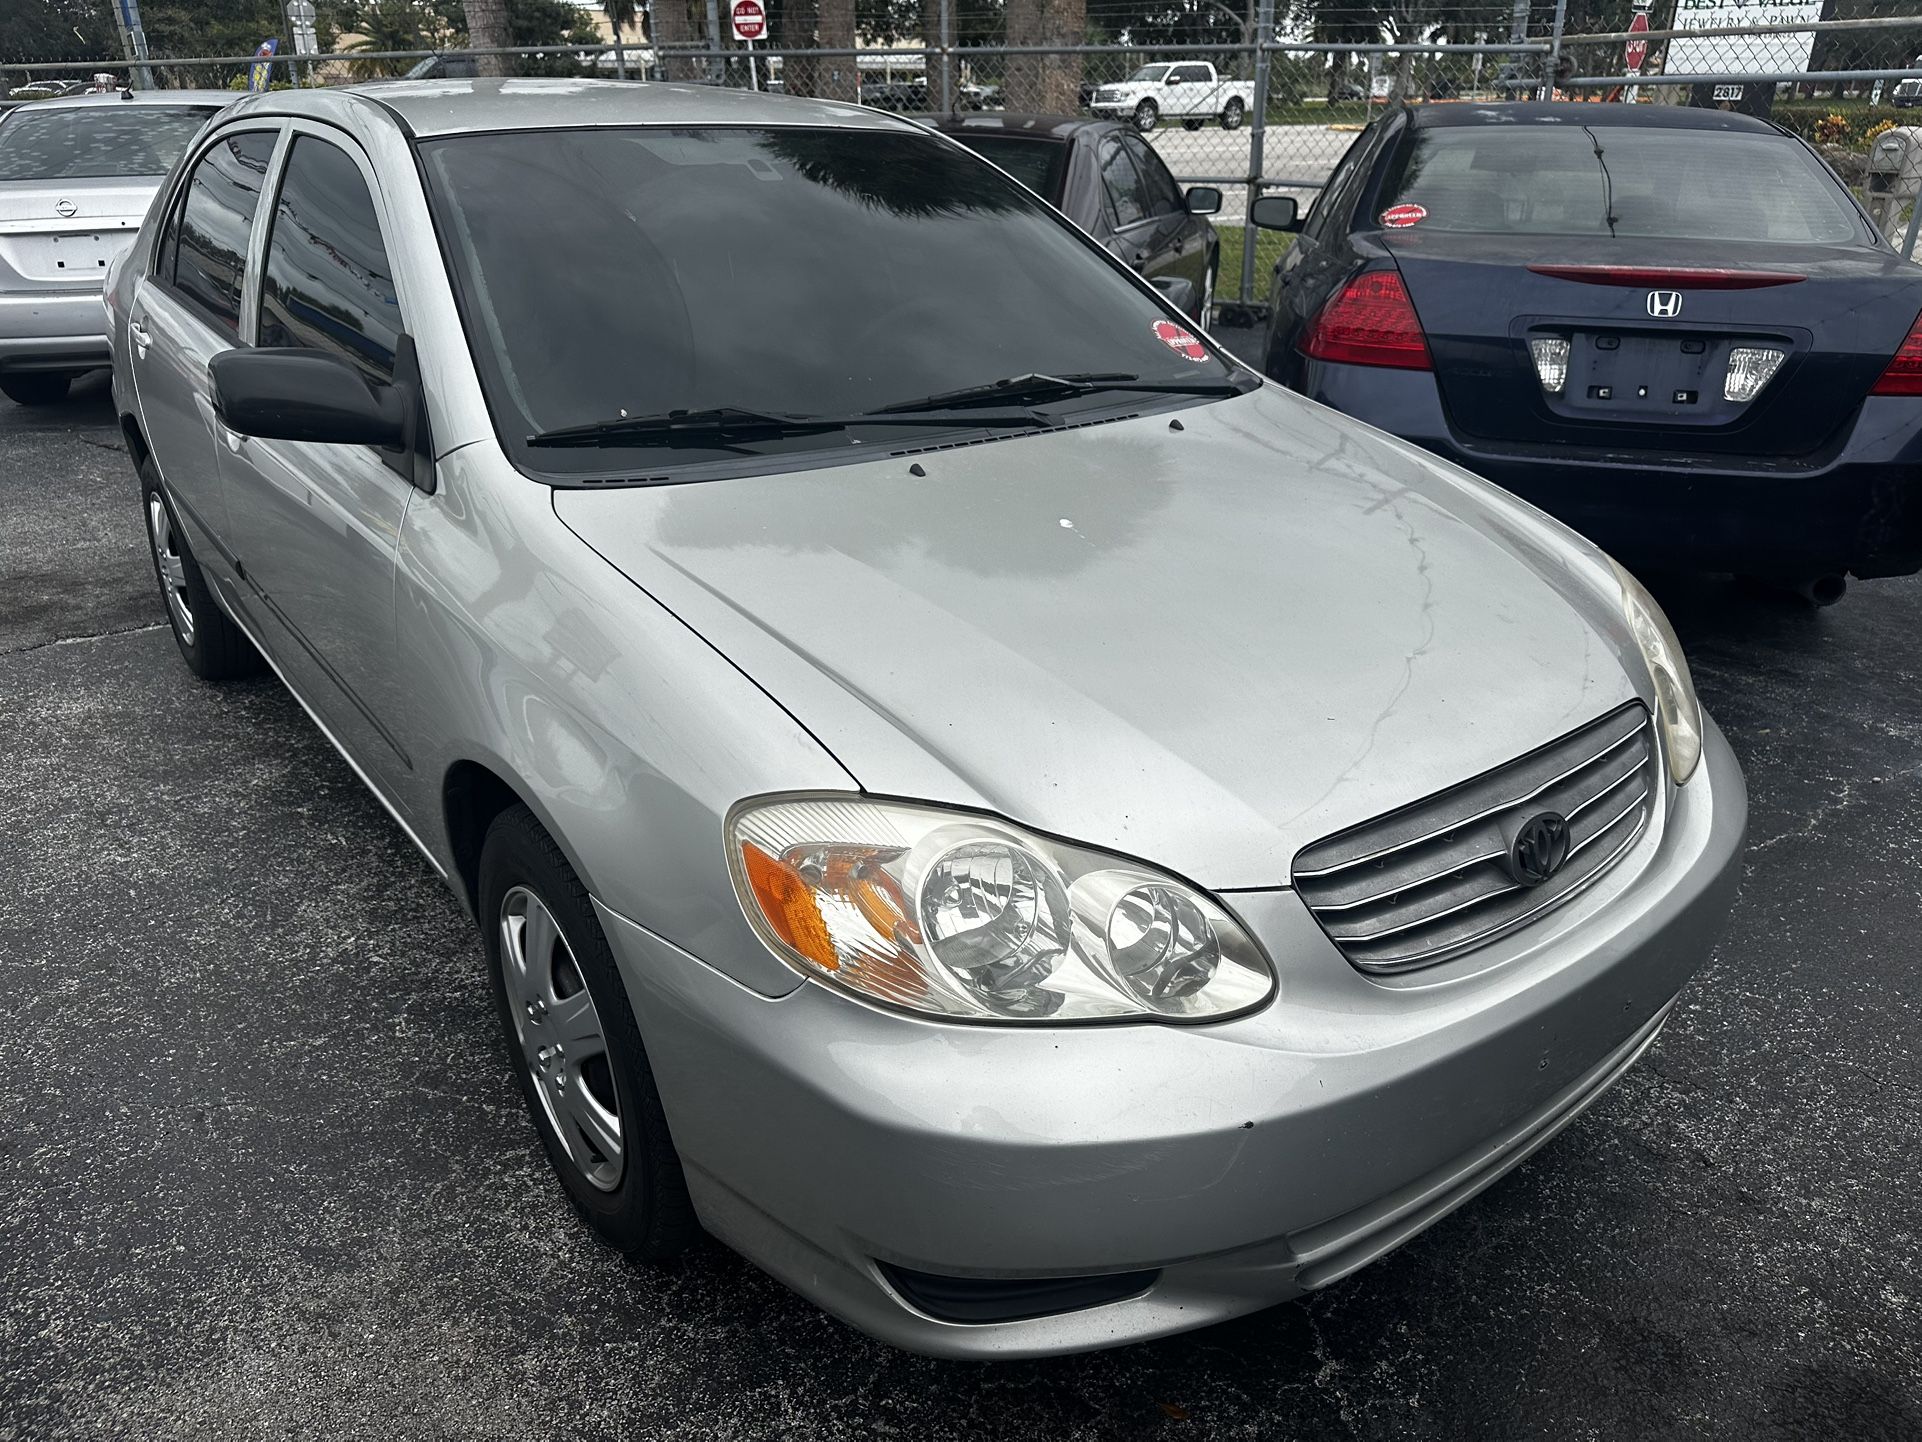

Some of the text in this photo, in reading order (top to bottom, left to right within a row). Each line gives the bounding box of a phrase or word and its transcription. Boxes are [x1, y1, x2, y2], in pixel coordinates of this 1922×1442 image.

[1684, 0, 1724, 10] BEST
[747, 6, 760, 14] NOT
[740, 24, 760, 32] ENTER
[1714, 86, 1742, 98] 2817
